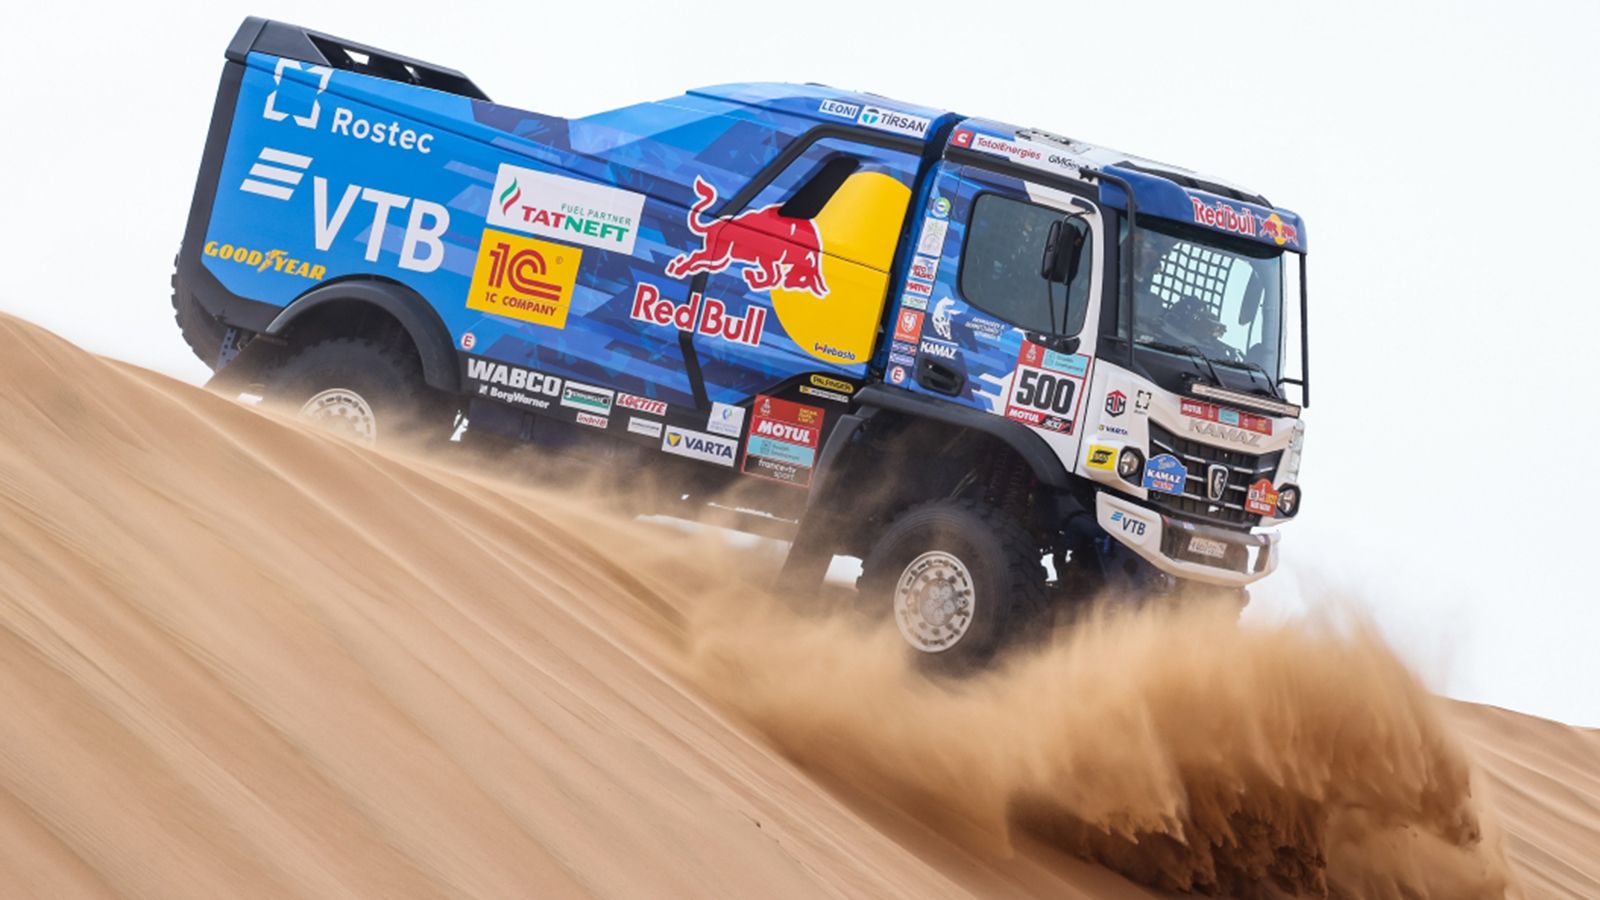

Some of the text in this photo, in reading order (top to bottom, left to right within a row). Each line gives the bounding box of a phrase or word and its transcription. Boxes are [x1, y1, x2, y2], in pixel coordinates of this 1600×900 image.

[821, 101, 857, 117] LEONI
[330, 106, 435, 154] Rostec
[977, 136, 1042, 160] TotalEnergies
[313, 175, 451, 274] VTB
[521, 204, 630, 243] TATNEFT
[560, 202, 633, 227] FUEL PARTNER
[1192, 197, 1257, 237] Red Bull
[203, 240, 327, 281] GOODYEAR
[484, 291, 558, 317] 1C COMPANY
[630, 281, 767, 347] Red Bull
[919, 341, 959, 361] KAMAZ
[466, 357, 563, 398] WABCO
[489, 386, 550, 410] BorgWarner
[617, 393, 666, 414] LOCTITE
[1015, 368, 1076, 415] 500
[1008, 407, 1040, 423] MOTUL
[757, 419, 811, 444] MOTUL
[1105, 425, 1129, 436] VARTA
[1187, 419, 1261, 448] KAMAZ
[684, 434, 734, 460] VARTA
[1146, 468, 1182, 484] KAMAZ
[1122, 516, 1147, 537] VTB
